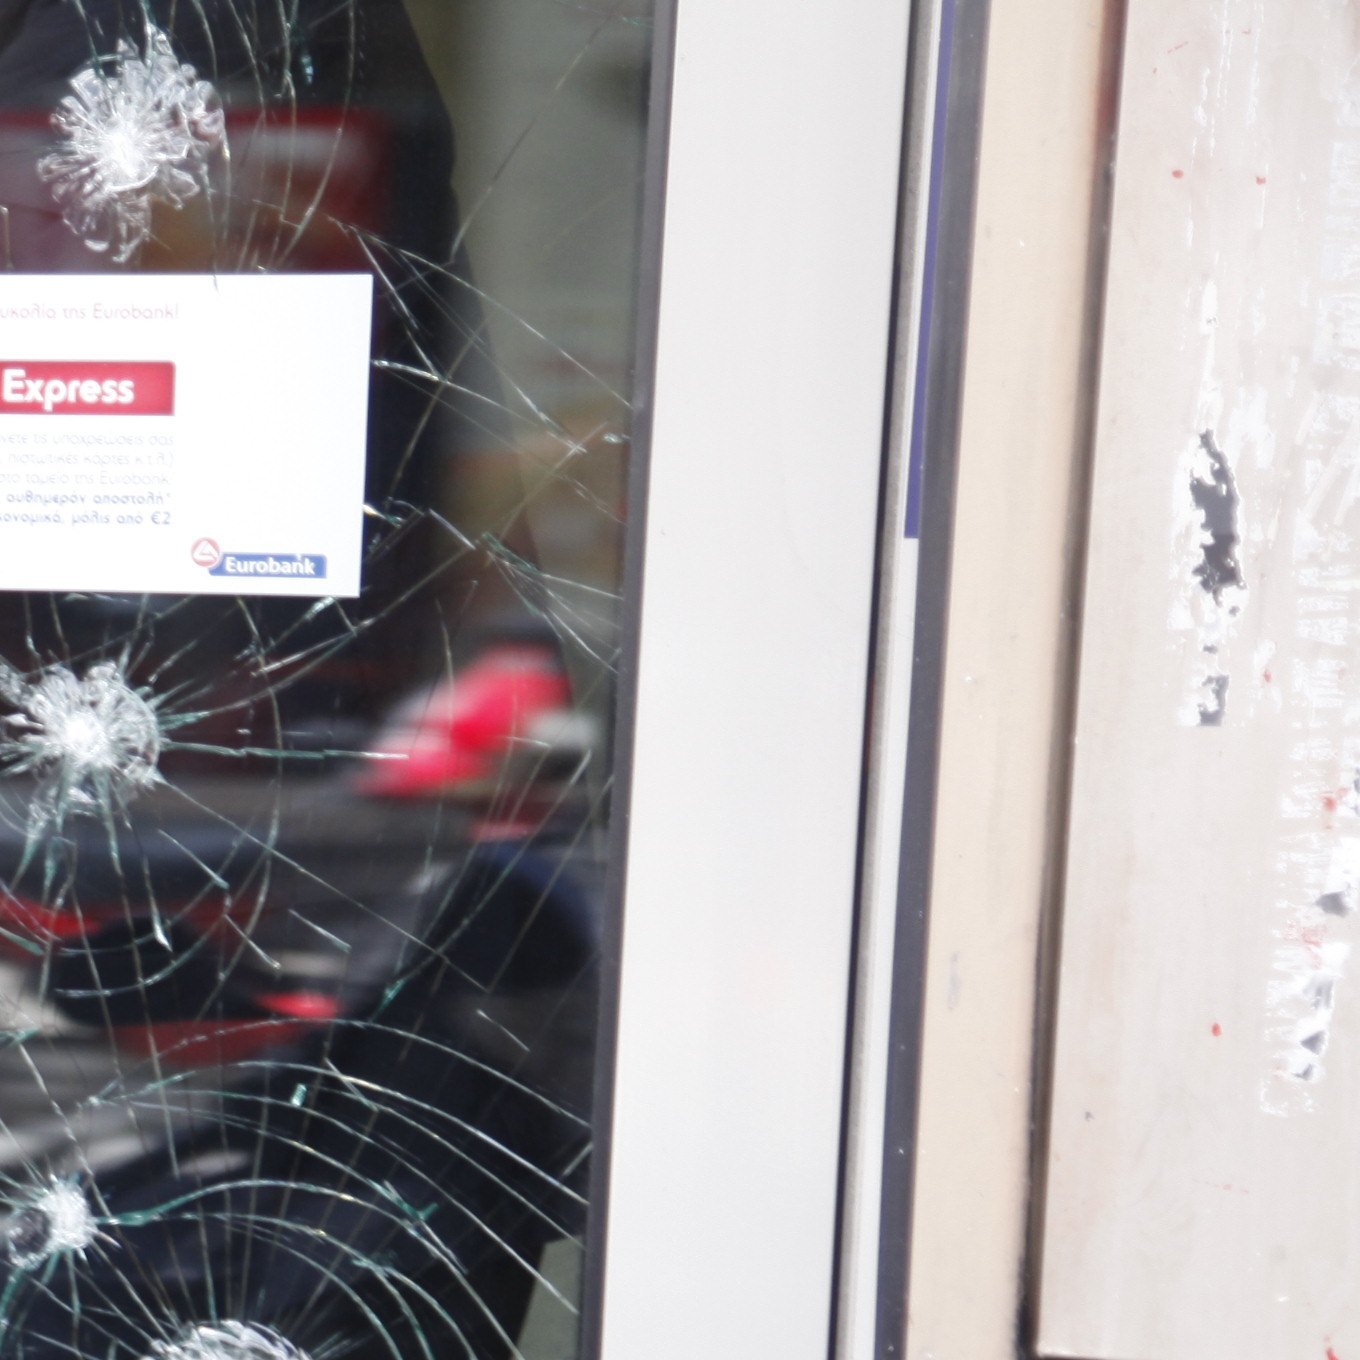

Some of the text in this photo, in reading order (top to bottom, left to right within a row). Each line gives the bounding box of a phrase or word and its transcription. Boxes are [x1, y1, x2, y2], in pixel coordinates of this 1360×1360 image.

[92, 300, 180, 320] Eurobank!
[3, 368, 135, 411] Express
[148, 433, 174, 446] σας
[150, 510, 172, 526] €2
[224, 556, 315, 575] Eurobank
